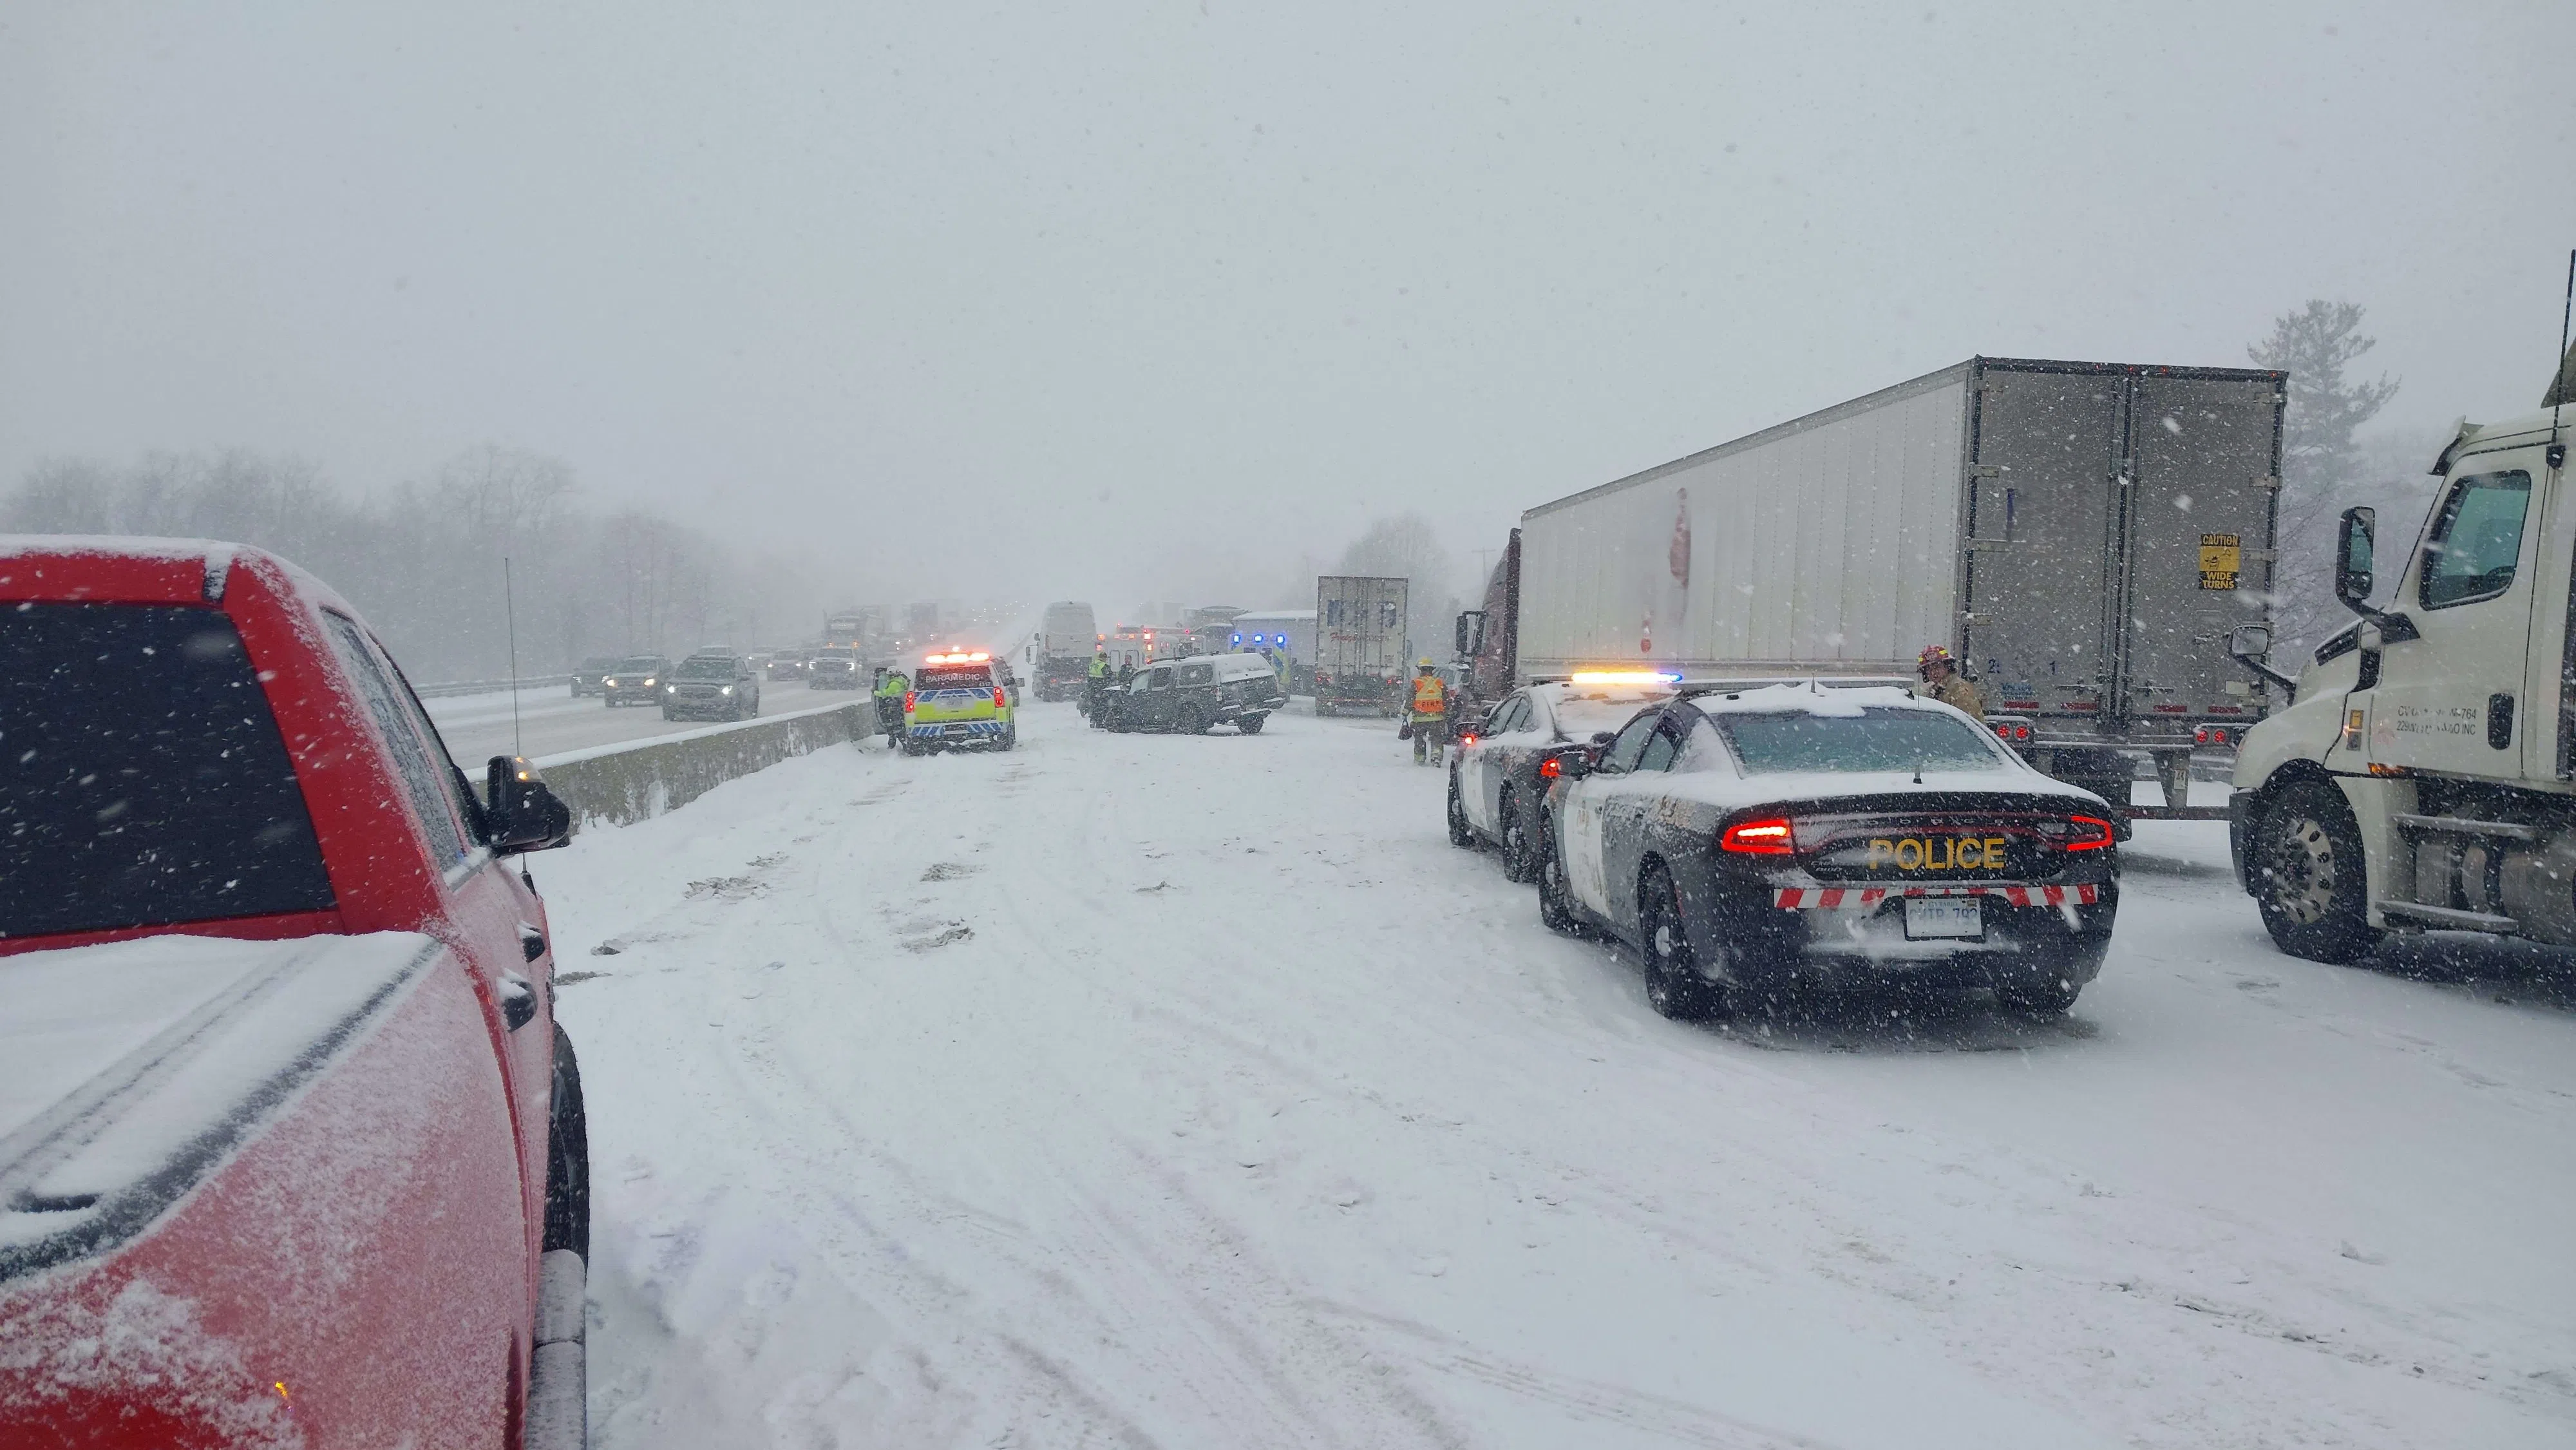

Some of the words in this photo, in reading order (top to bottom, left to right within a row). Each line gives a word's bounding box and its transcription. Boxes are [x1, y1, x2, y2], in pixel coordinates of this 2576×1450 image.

[2202, 534, 2239, 546] CAUTION
[2206, 571, 2232, 580] WIDE
[2202, 580, 2235, 589] TURNS
[925, 673, 980, 683] PARAMEDIC
[2462, 723, 2476, 735] INC
[1870, 838, 2005, 870] POLICE
